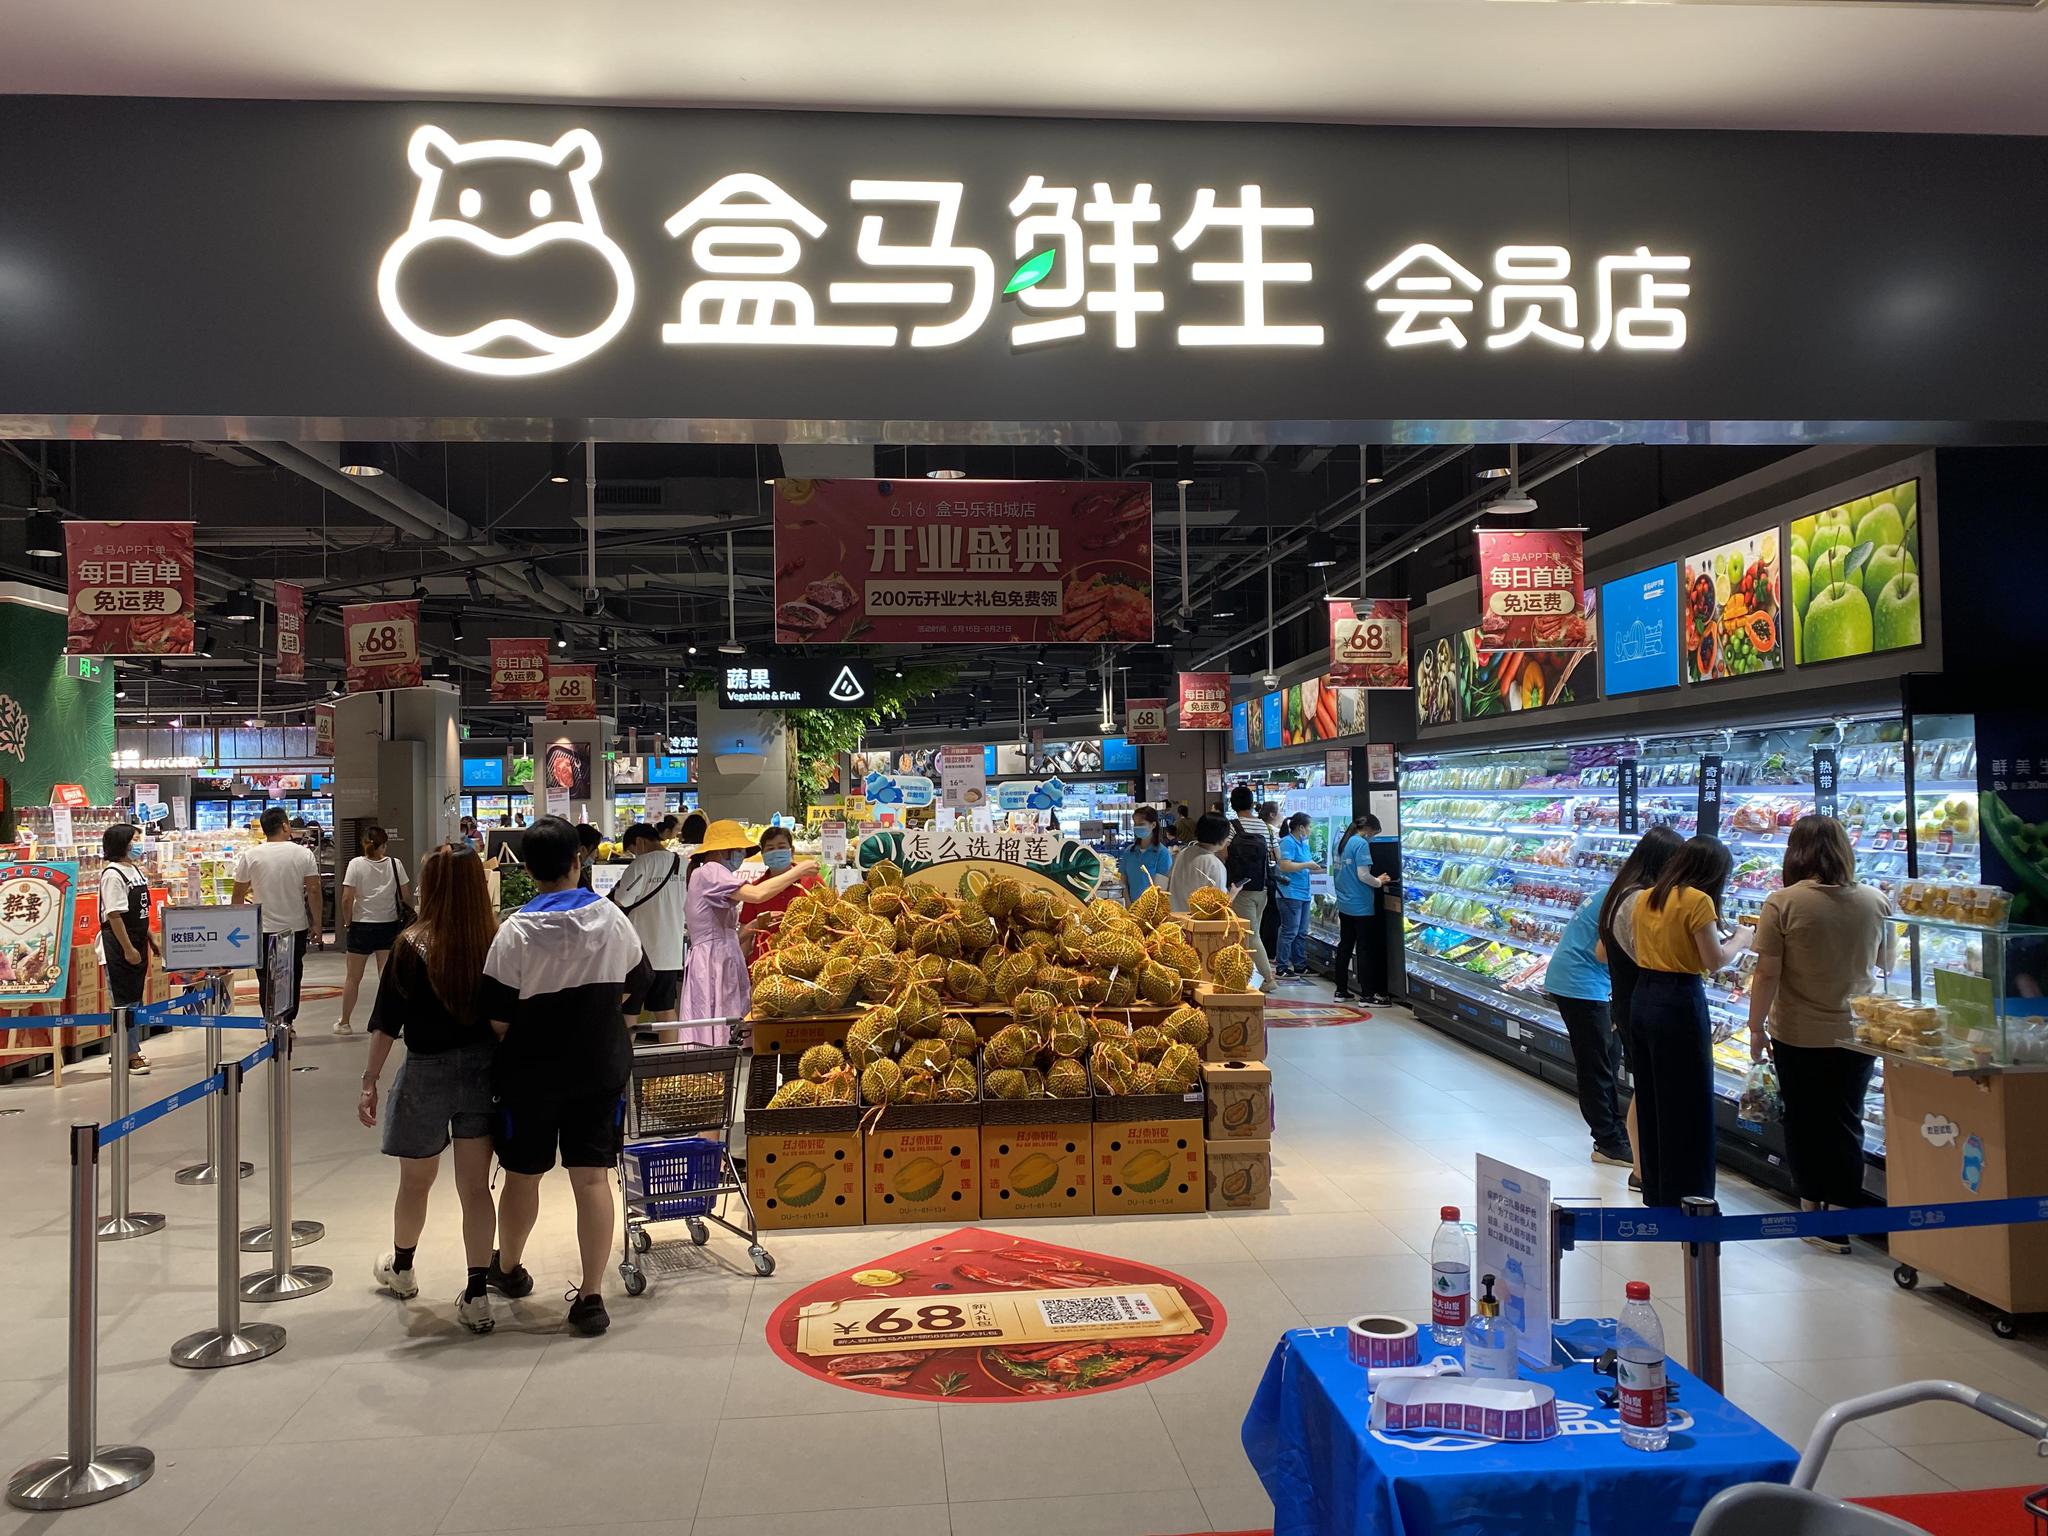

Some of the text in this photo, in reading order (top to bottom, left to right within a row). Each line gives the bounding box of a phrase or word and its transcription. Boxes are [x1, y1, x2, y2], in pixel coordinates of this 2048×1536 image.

[662, 172, 1691, 351] 盒马鲜生 会员店
[890, 500, 1036, 518] 6.16 盒马乐和城店
[93, 544, 168, 556] 盒马APP下单
[866, 524, 1062, 573] 开业盛典
[1501, 552, 1561, 562] 盒马APP下单
[78, 560, 182, 585] 每日首单
[1490, 566, 1574, 588] 每日首单
[94, 590, 165, 612] 免运费
[871, 590, 1057, 607] 200元开业大礼包免费领
[1503, 593, 1562, 612] 免运费
[358, 626, 397, 652] ¥68
[1344, 624, 1383, 650] ¥68
[496, 657, 543, 669] 每日首单
[503, 671, 536, 681] 免运费
[726, 668, 770, 689] 蔬果
[727, 691, 800, 702] Vegetable & Fruit
[1184, 689, 1226, 700] 每日首单
[1191, 702, 1219, 712] 免运费
[1703, 766, 1718, 802] 奇异果
[909, 834, 1050, 863] 怎么选榴莲
[171, 932, 217, 943] 收银入口
[1637, 1223, 1659, 1235] 盒马
[834, 1305, 966, 1335] ¥68
[972, 1303, 992, 1327] 新人礼包
